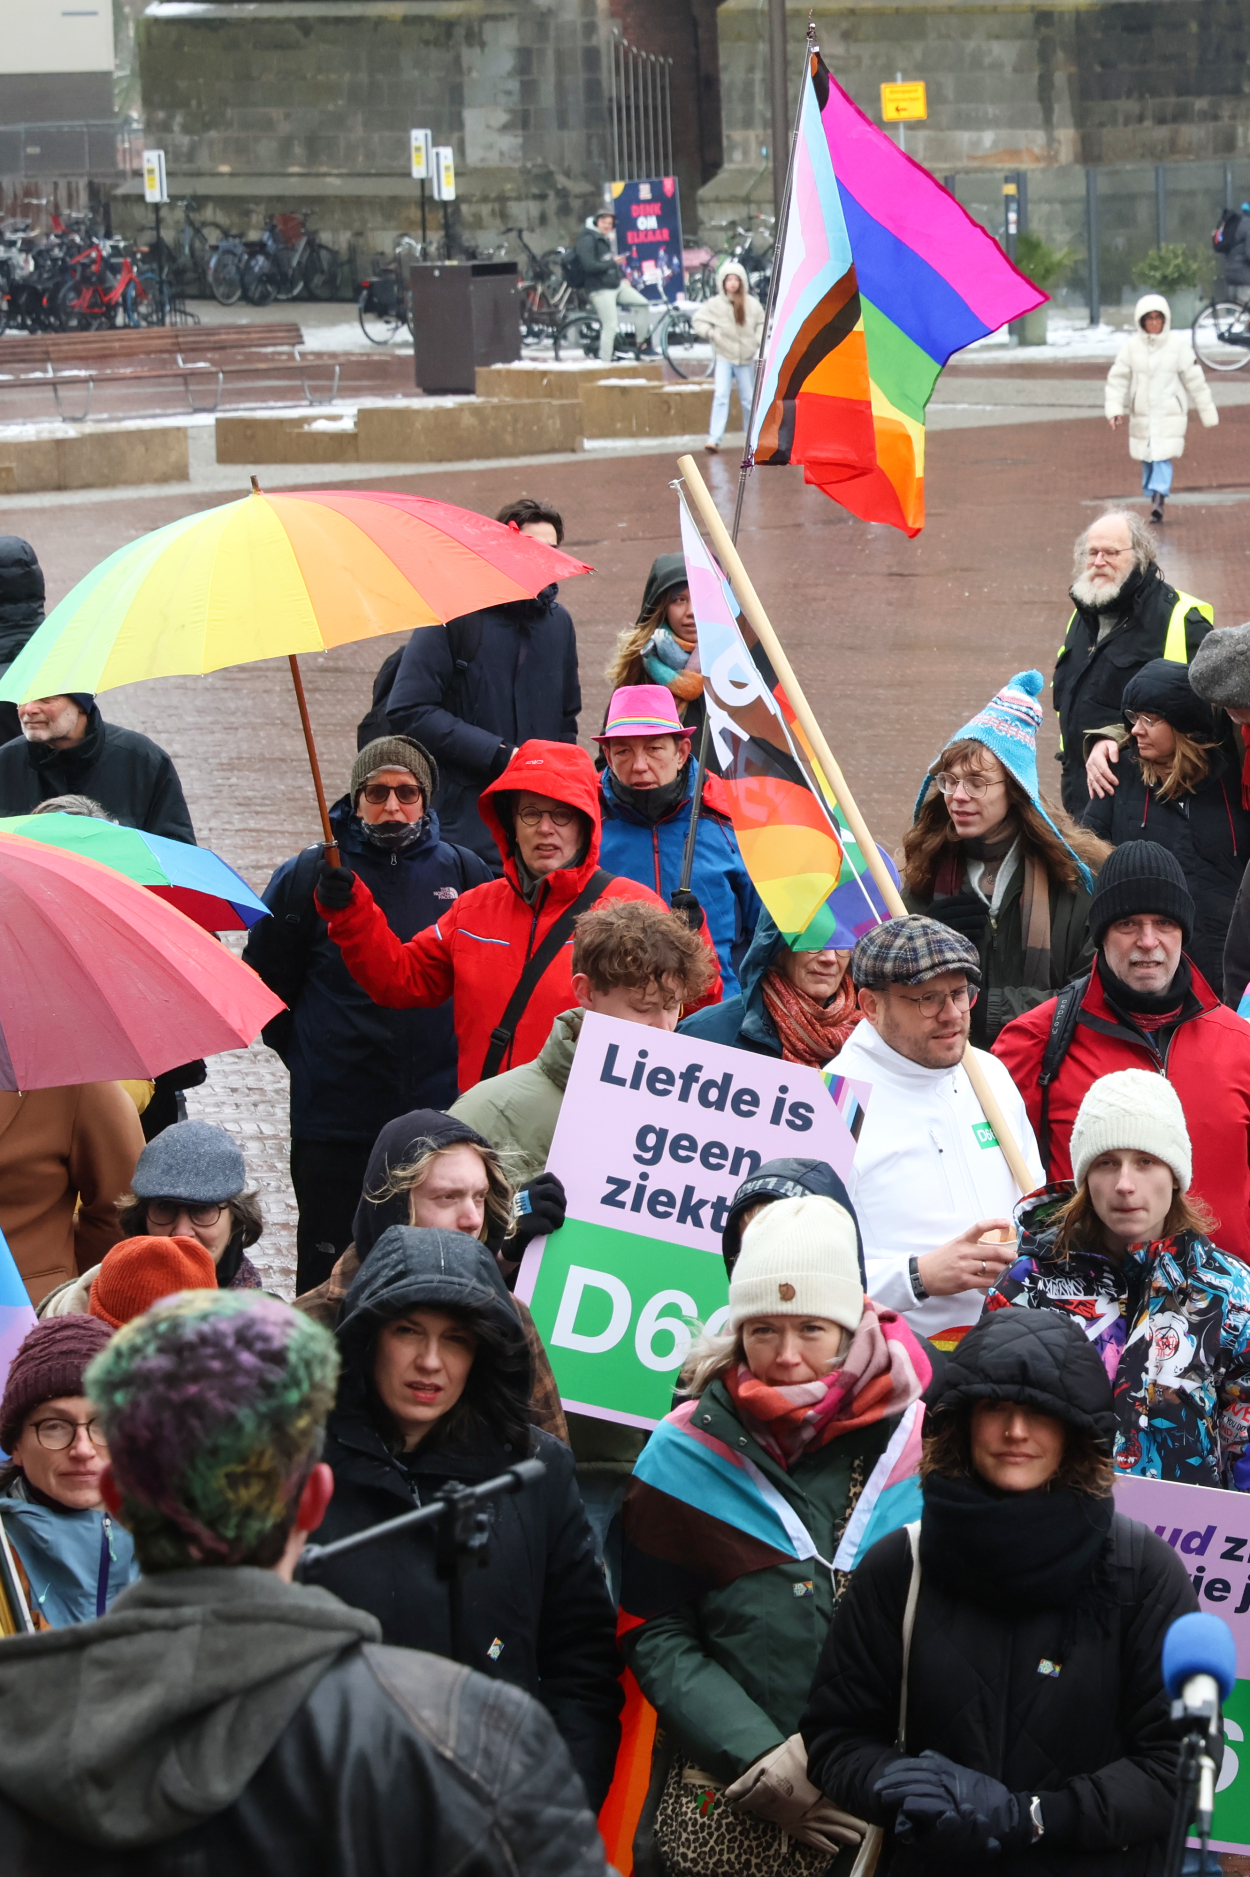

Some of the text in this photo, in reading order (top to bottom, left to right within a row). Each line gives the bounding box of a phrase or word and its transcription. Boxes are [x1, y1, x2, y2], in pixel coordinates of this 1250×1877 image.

[631, 202, 662, 218] DENK
[636, 215, 658, 230] OM
[626, 227, 670, 244] ELKAAR
[600, 1043, 815, 1132] Liefde is
[633, 1124, 762, 1177] geen
